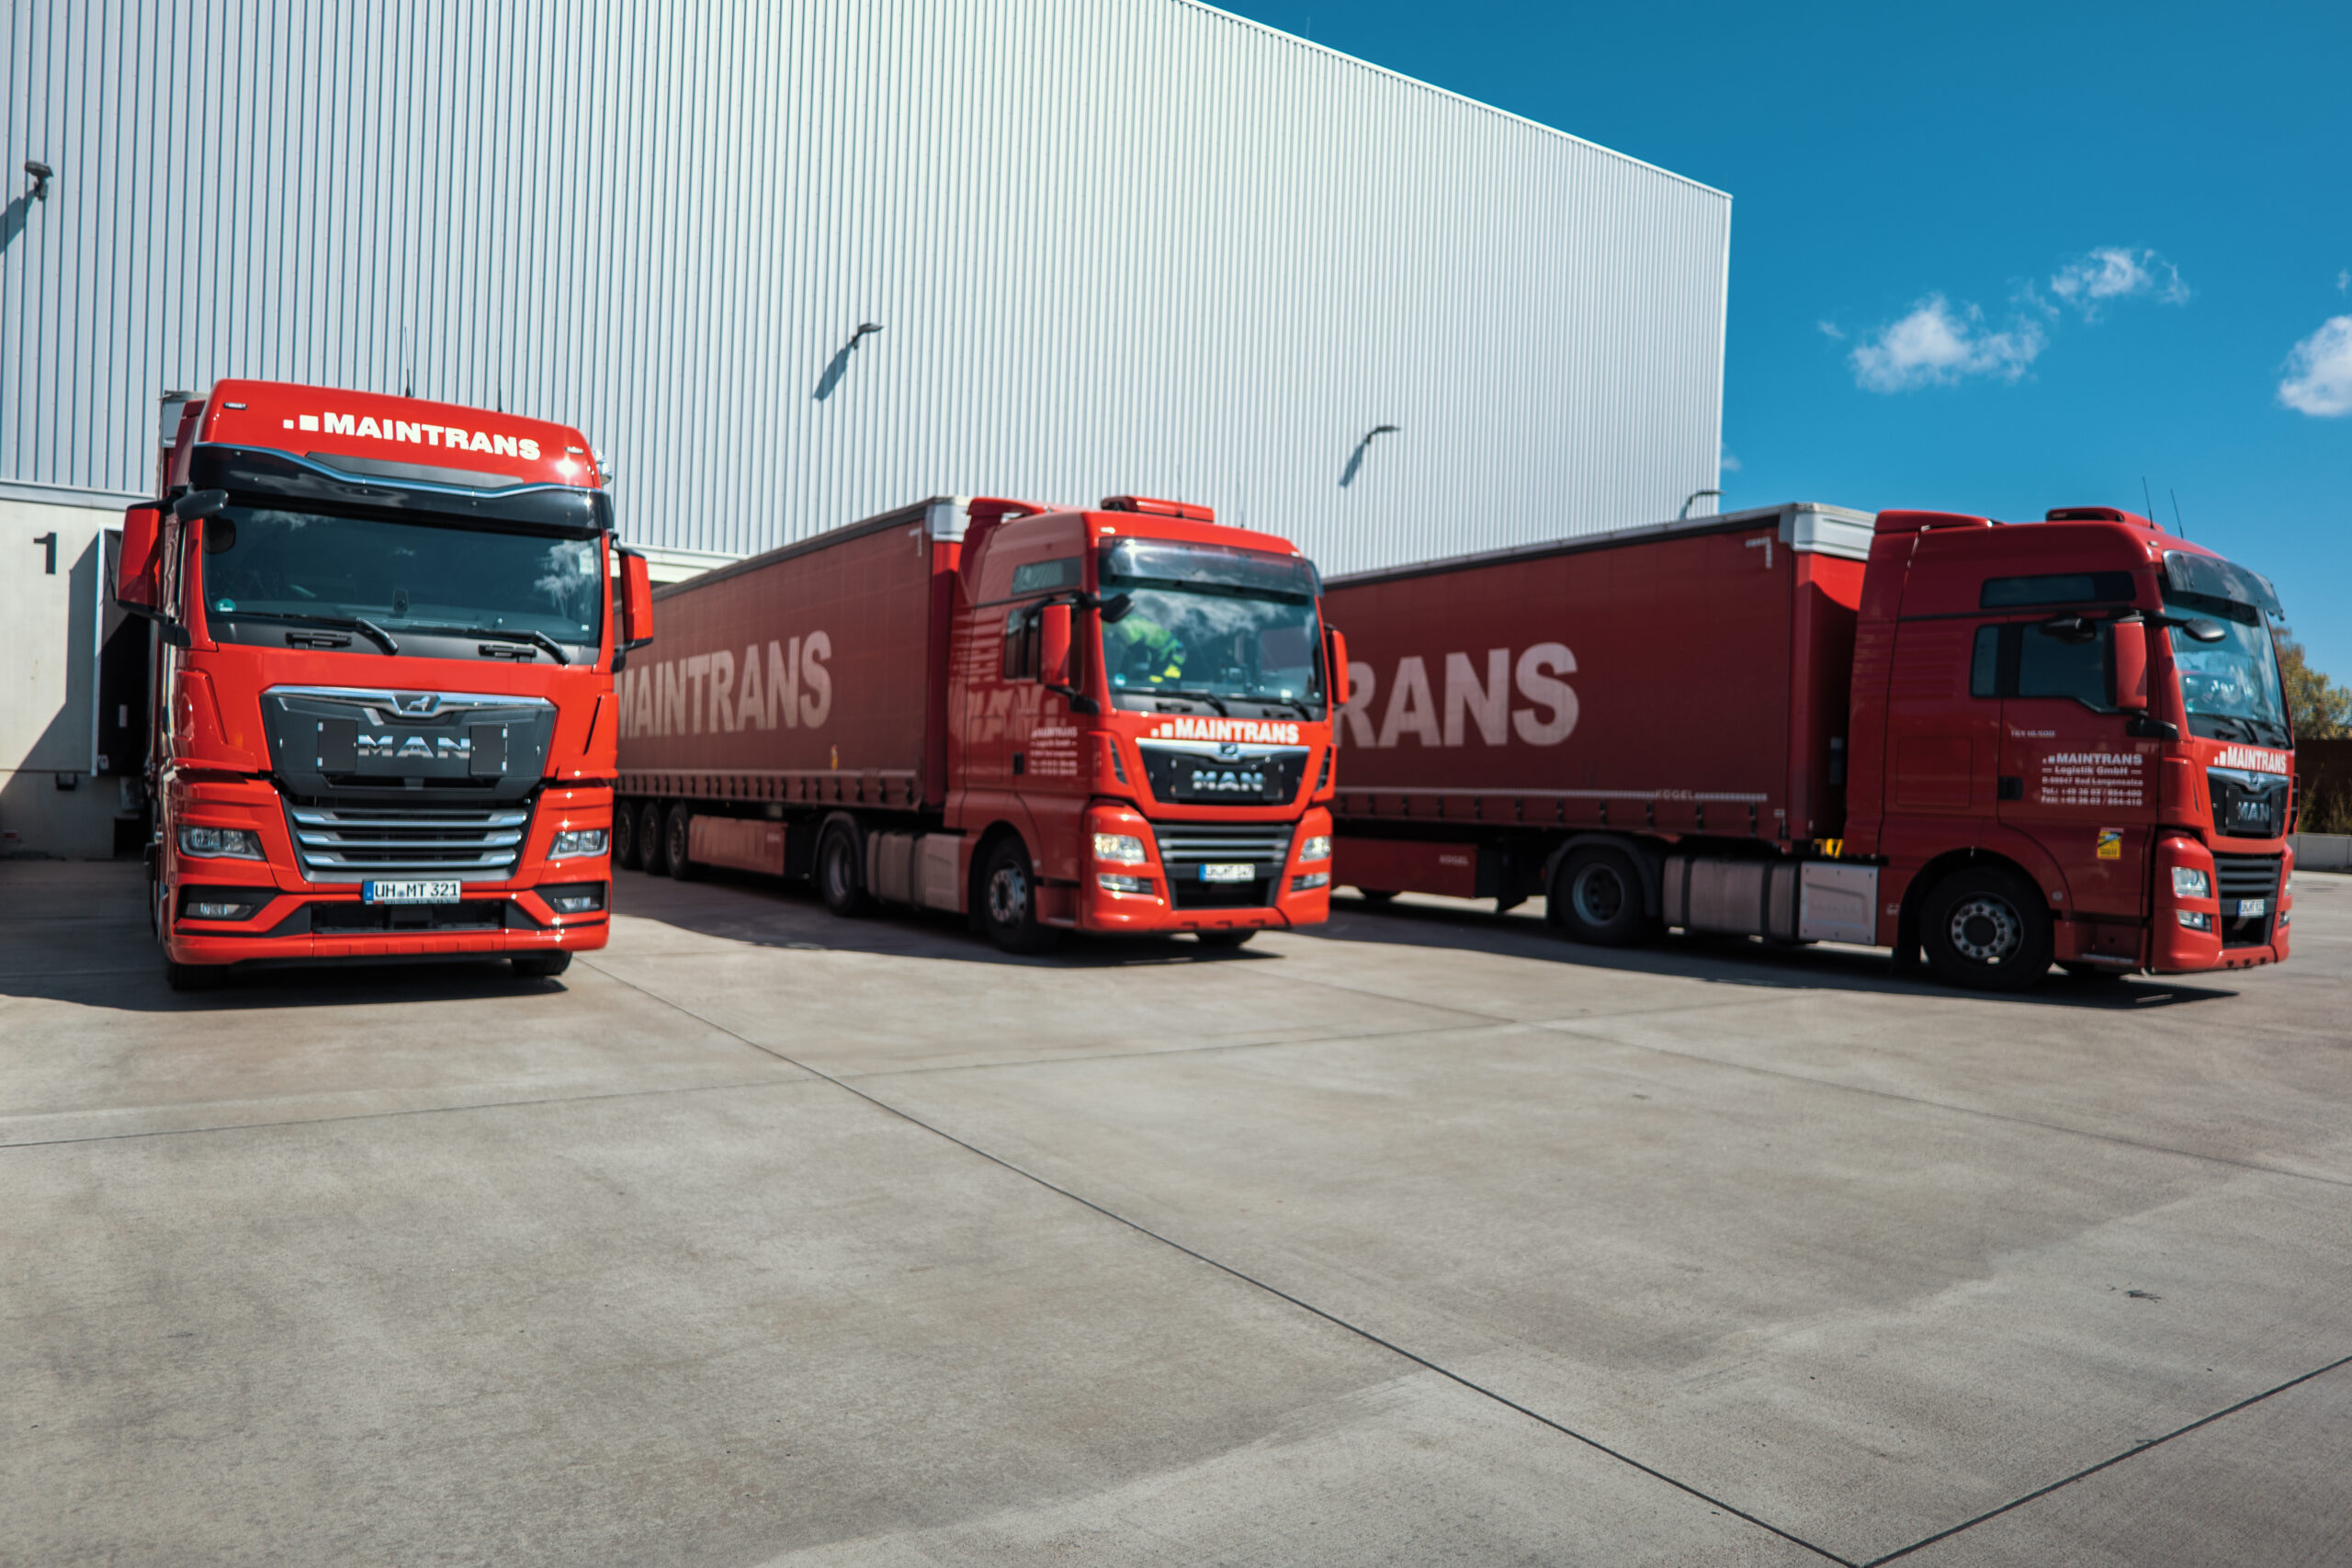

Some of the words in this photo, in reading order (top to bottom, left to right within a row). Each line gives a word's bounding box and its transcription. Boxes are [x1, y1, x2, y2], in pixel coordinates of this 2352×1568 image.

[324, 412, 540, 460] MAINTRANS
[33, 532, 57, 575] 1
[1175, 717, 1299, 744] MAINTRANS
[358, 735, 470, 759] MAN
[2056, 752, 2143, 765] MAINTRANS
[2227, 746, 2287, 774] MAINTRANS
[1193, 771, 1263, 791] MAN
[2054, 765, 2094, 774] Logistik
[2097, 766, 2128, 775] GmbH
[2238, 801, 2270, 822] MAN
[375, 884, 395, 897] UH
[406, 883, 426, 897] MT
[430, 883, 458, 897] 321
